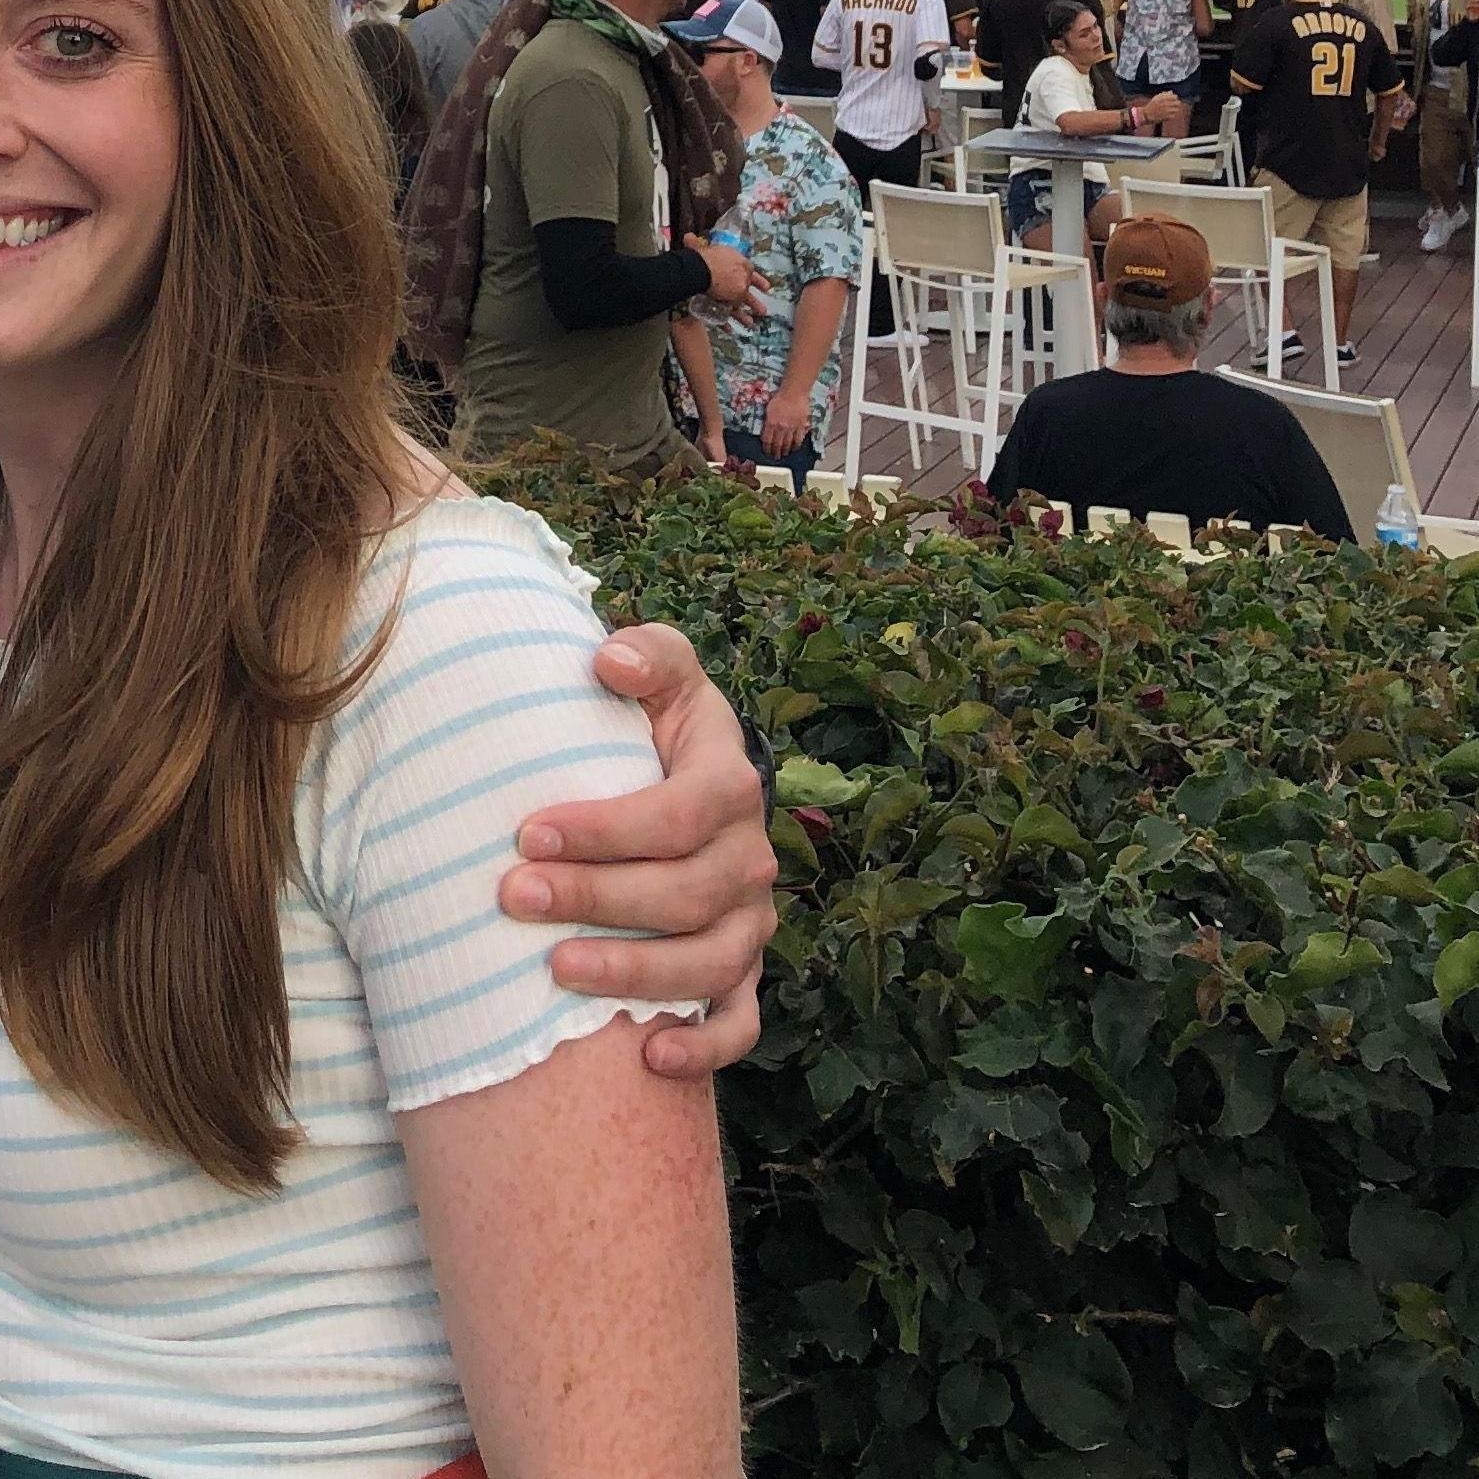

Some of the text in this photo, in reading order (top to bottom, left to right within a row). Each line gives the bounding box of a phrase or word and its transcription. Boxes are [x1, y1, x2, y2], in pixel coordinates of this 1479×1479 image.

[853, 20, 893, 69] 13
[1291, 11, 1367, 43] ARROYO
[1311, 41, 1356, 97] 21
